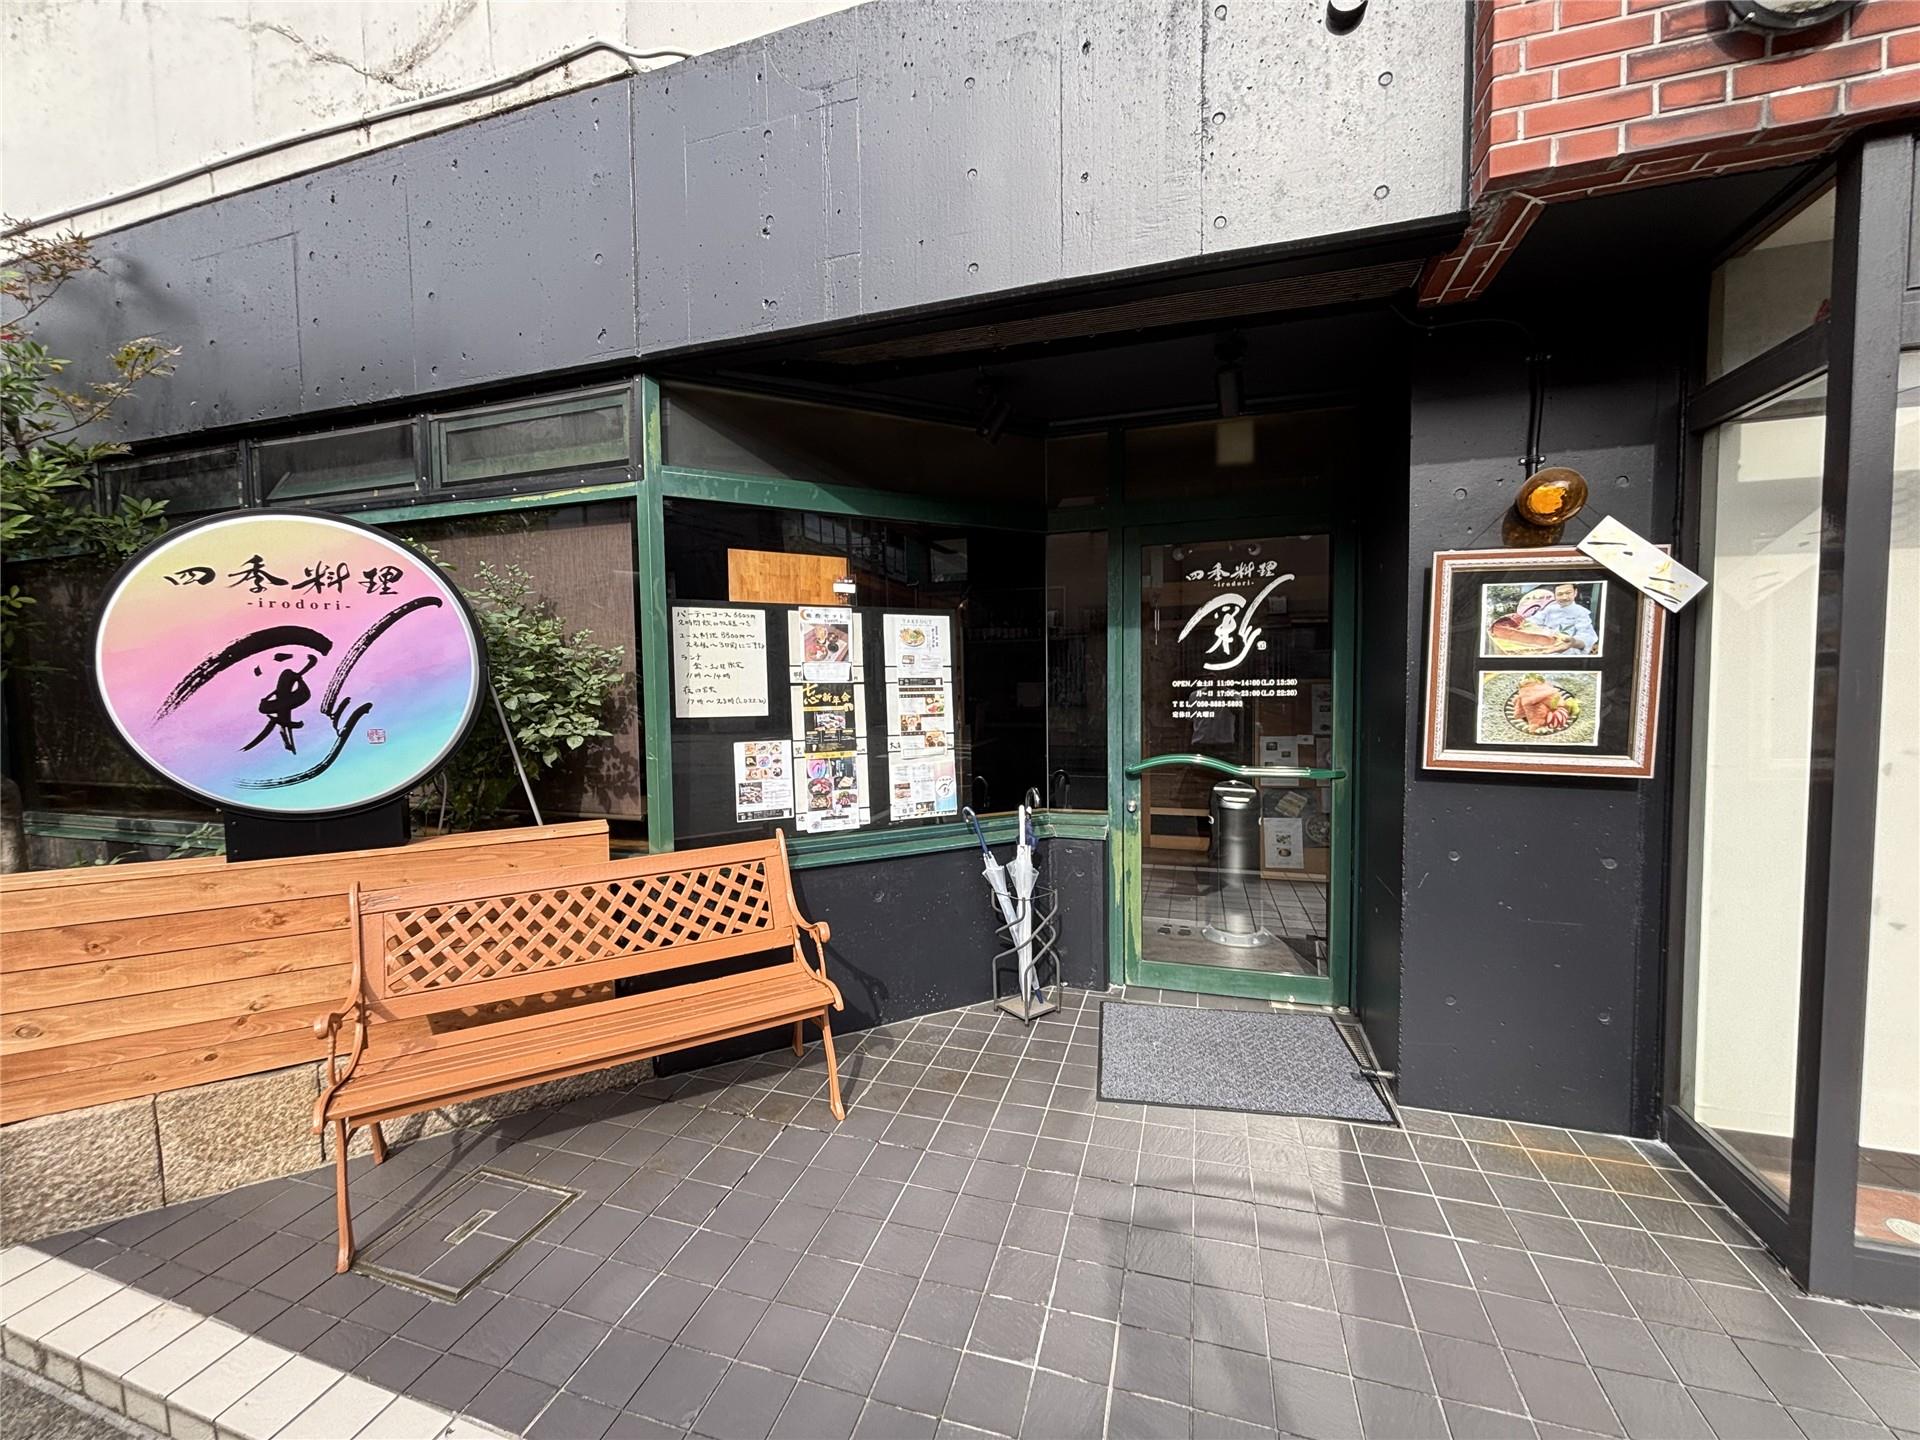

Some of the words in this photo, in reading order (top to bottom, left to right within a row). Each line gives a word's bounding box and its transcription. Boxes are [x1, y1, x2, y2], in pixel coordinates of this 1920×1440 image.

[163, 554, 404, 595] 四季料理
[1185, 560, 1278, 581] 四季料理
[1177, 573, 1295, 671] 彩
[152, 597, 443, 790] 彩
